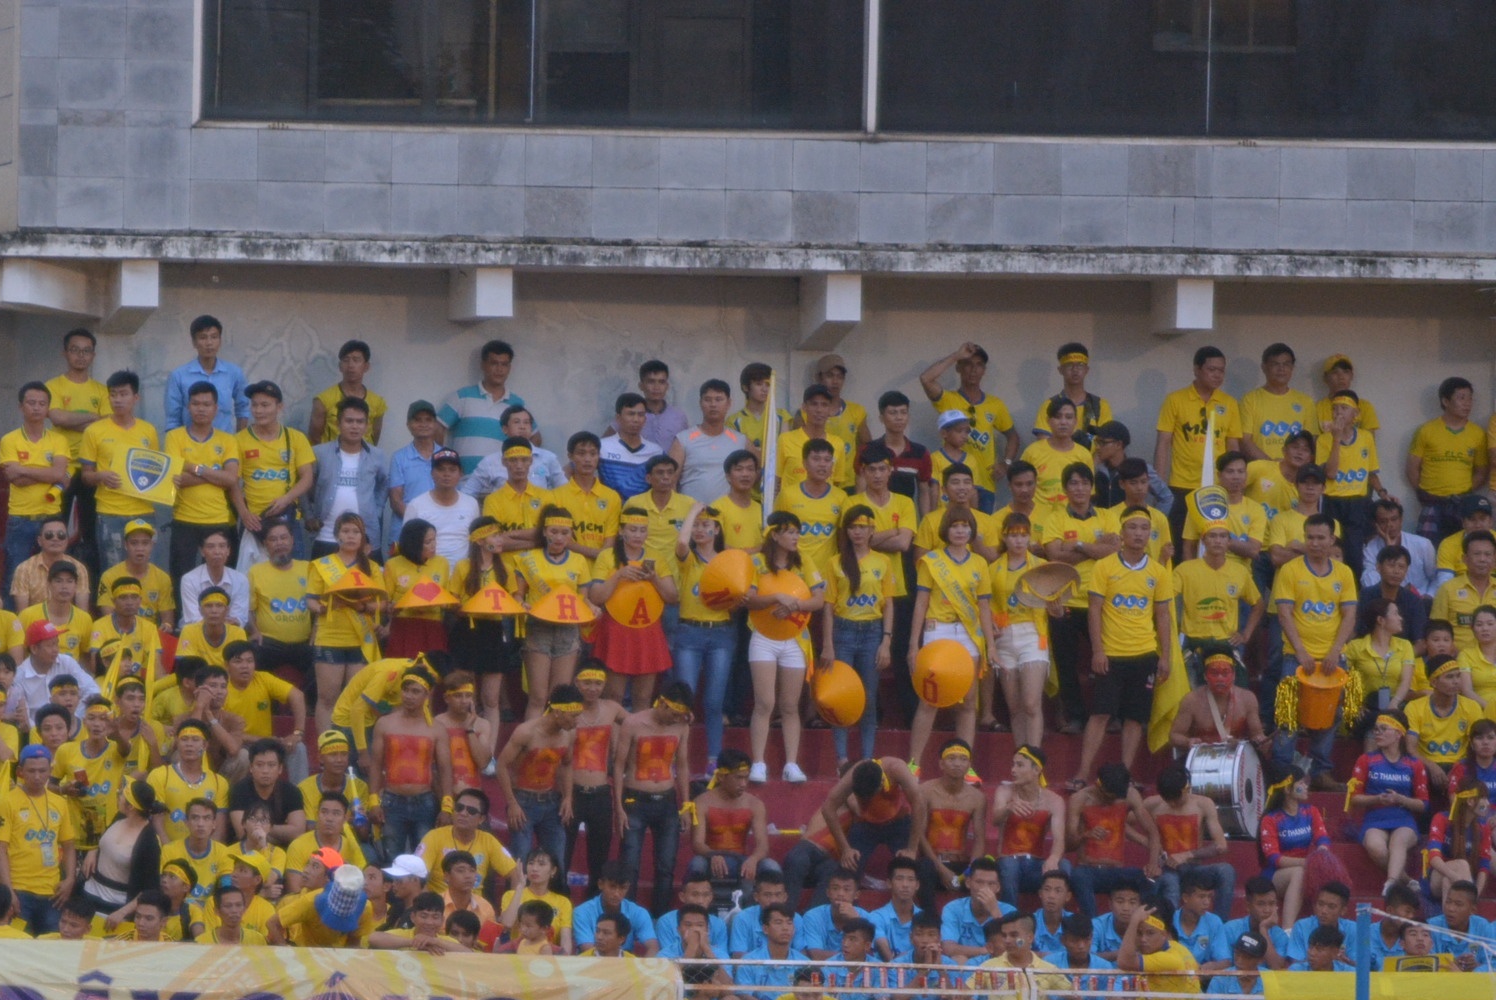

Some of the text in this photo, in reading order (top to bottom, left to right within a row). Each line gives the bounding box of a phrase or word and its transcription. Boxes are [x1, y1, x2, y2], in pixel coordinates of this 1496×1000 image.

[484, 588, 506, 611] T
[556, 594, 580, 620] H
[629, 597, 652, 626] A
